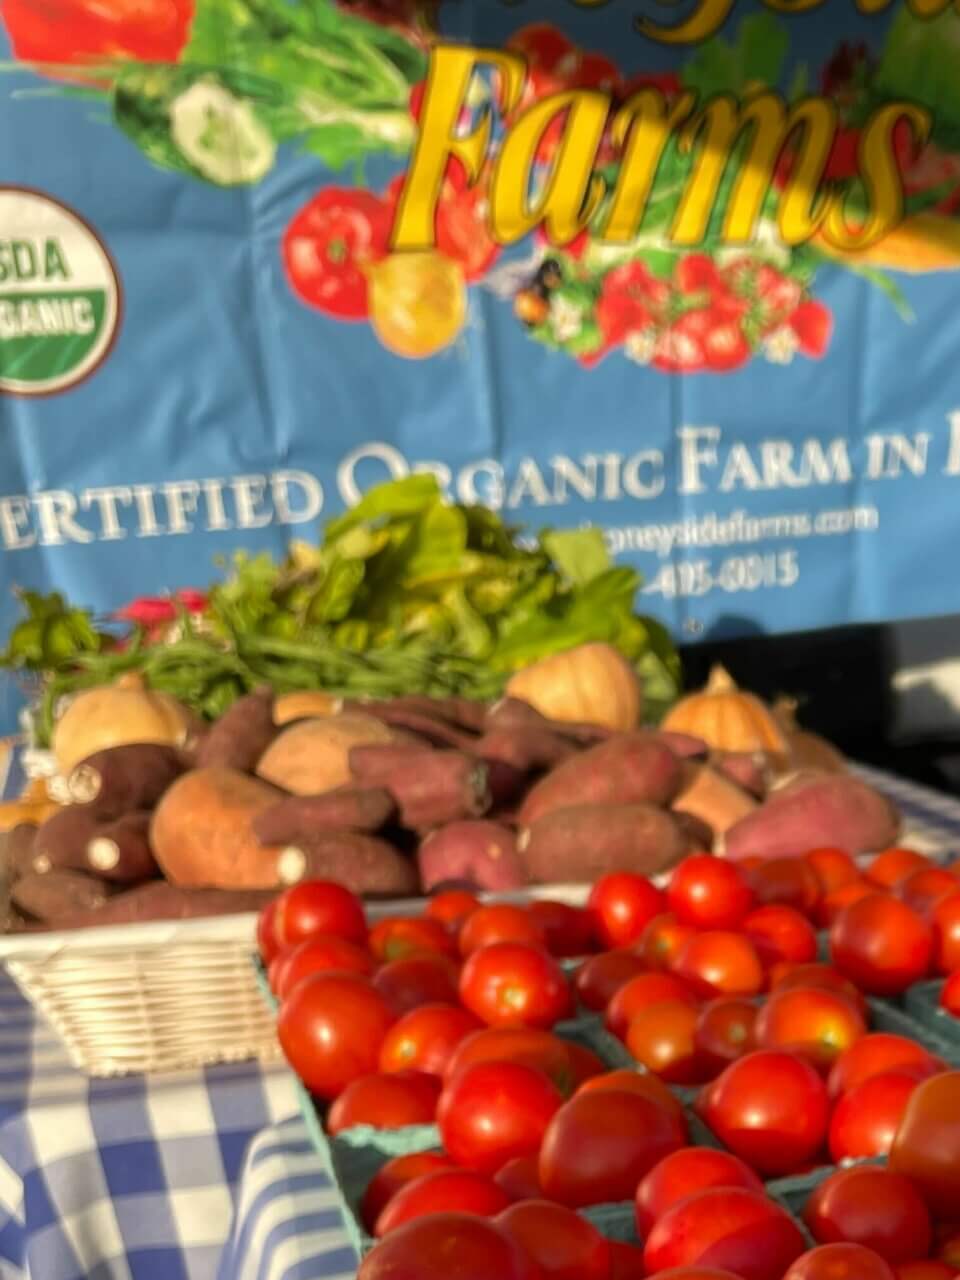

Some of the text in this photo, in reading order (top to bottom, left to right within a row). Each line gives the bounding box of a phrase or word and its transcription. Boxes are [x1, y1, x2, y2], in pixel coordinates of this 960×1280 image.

[387, 43, 933, 253] Farms
[0, 469, 324, 550] ERTIFIED
[677, 426, 852, 494] FARM
